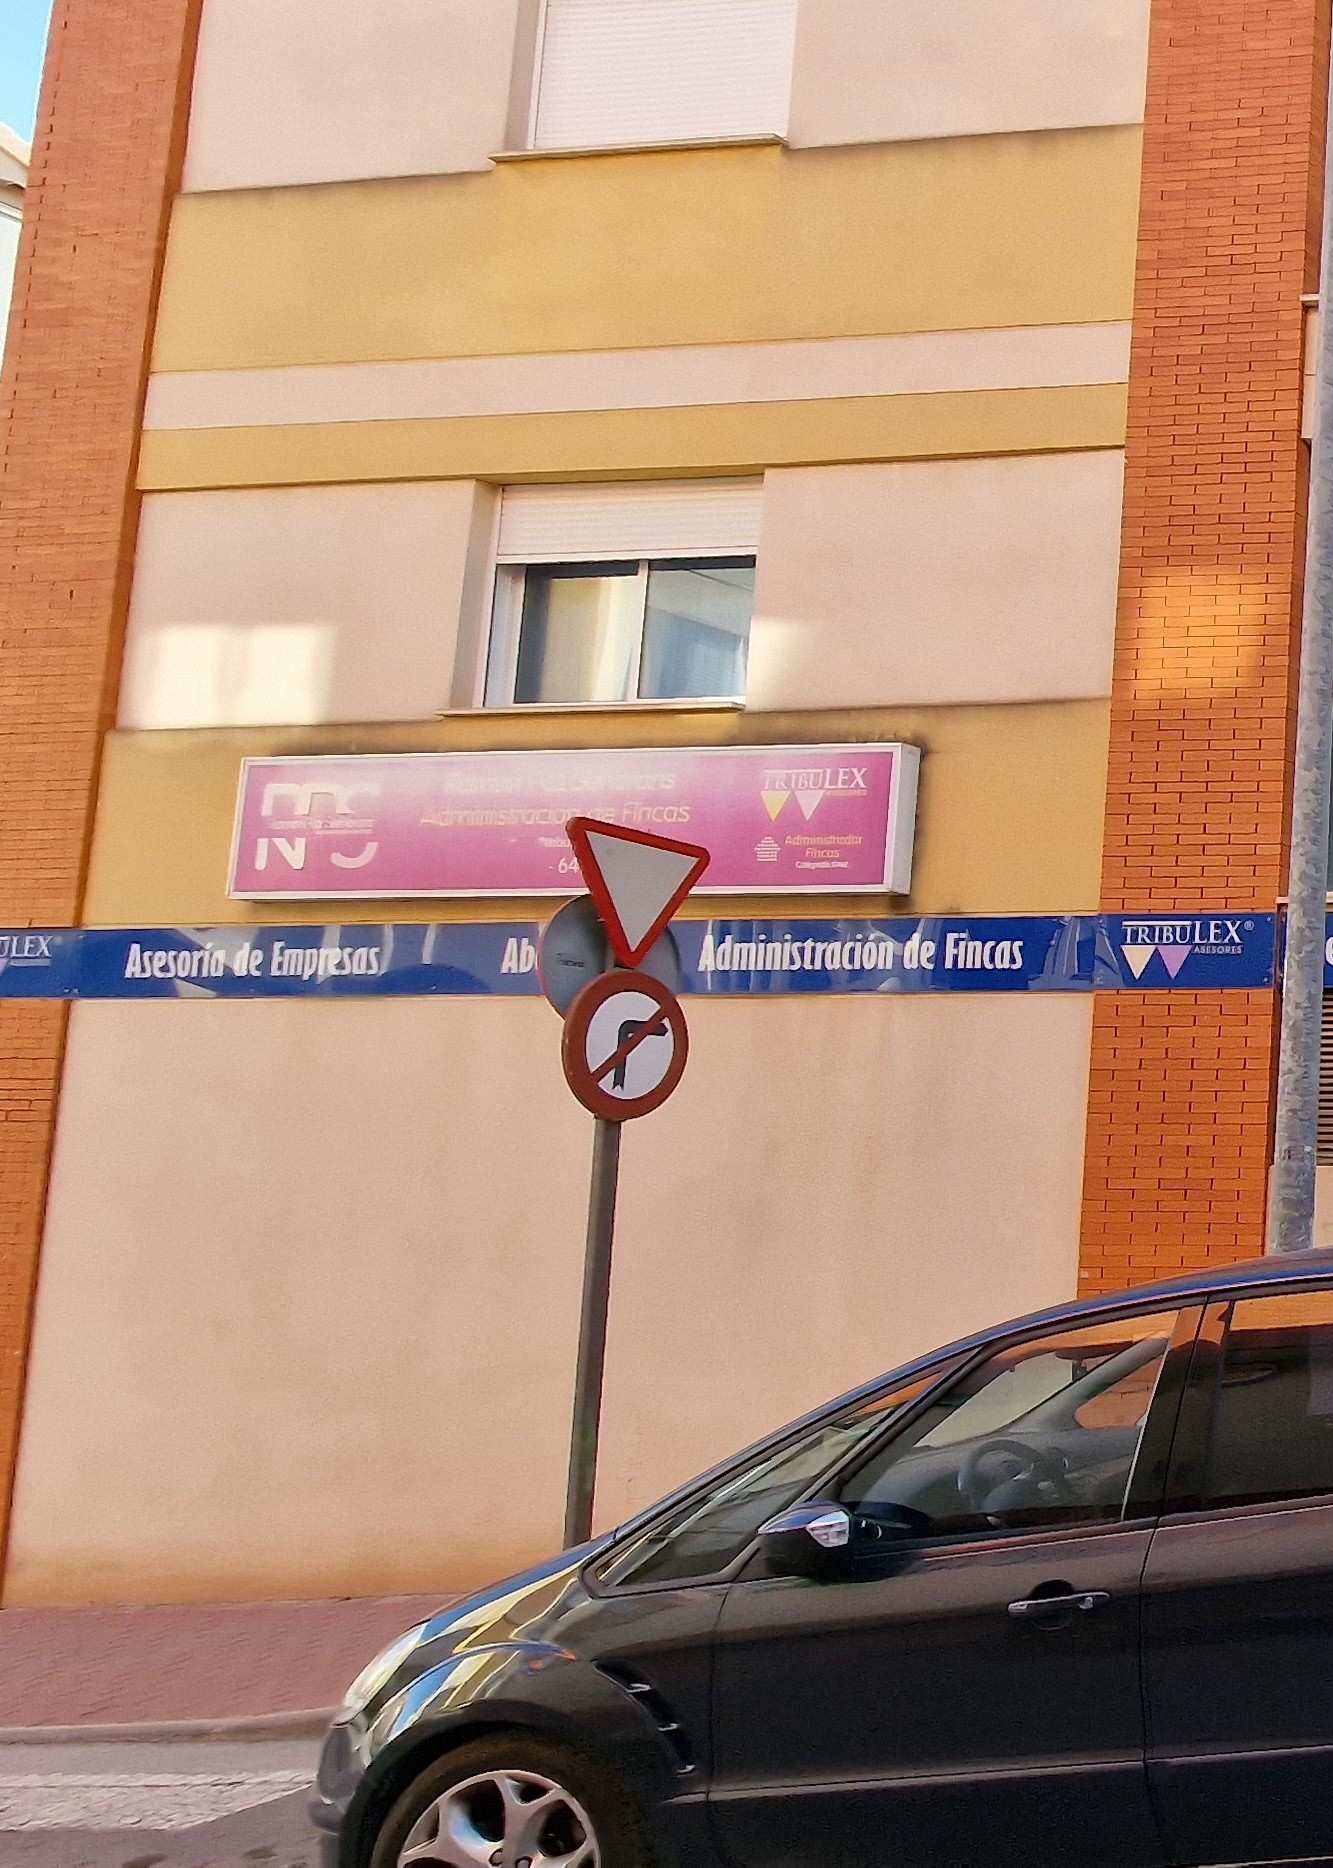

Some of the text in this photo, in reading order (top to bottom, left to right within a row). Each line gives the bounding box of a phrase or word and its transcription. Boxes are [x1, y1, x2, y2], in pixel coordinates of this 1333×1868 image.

[764, 767, 868, 790] TRIBULEX
[622, 802, 691, 823] Fincas
[698, 932, 1024, 972] Administración de Fincas
[1194, 945, 1242, 954] ASESORES
[124, 941, 380, 982] Asesoría de Empresas
